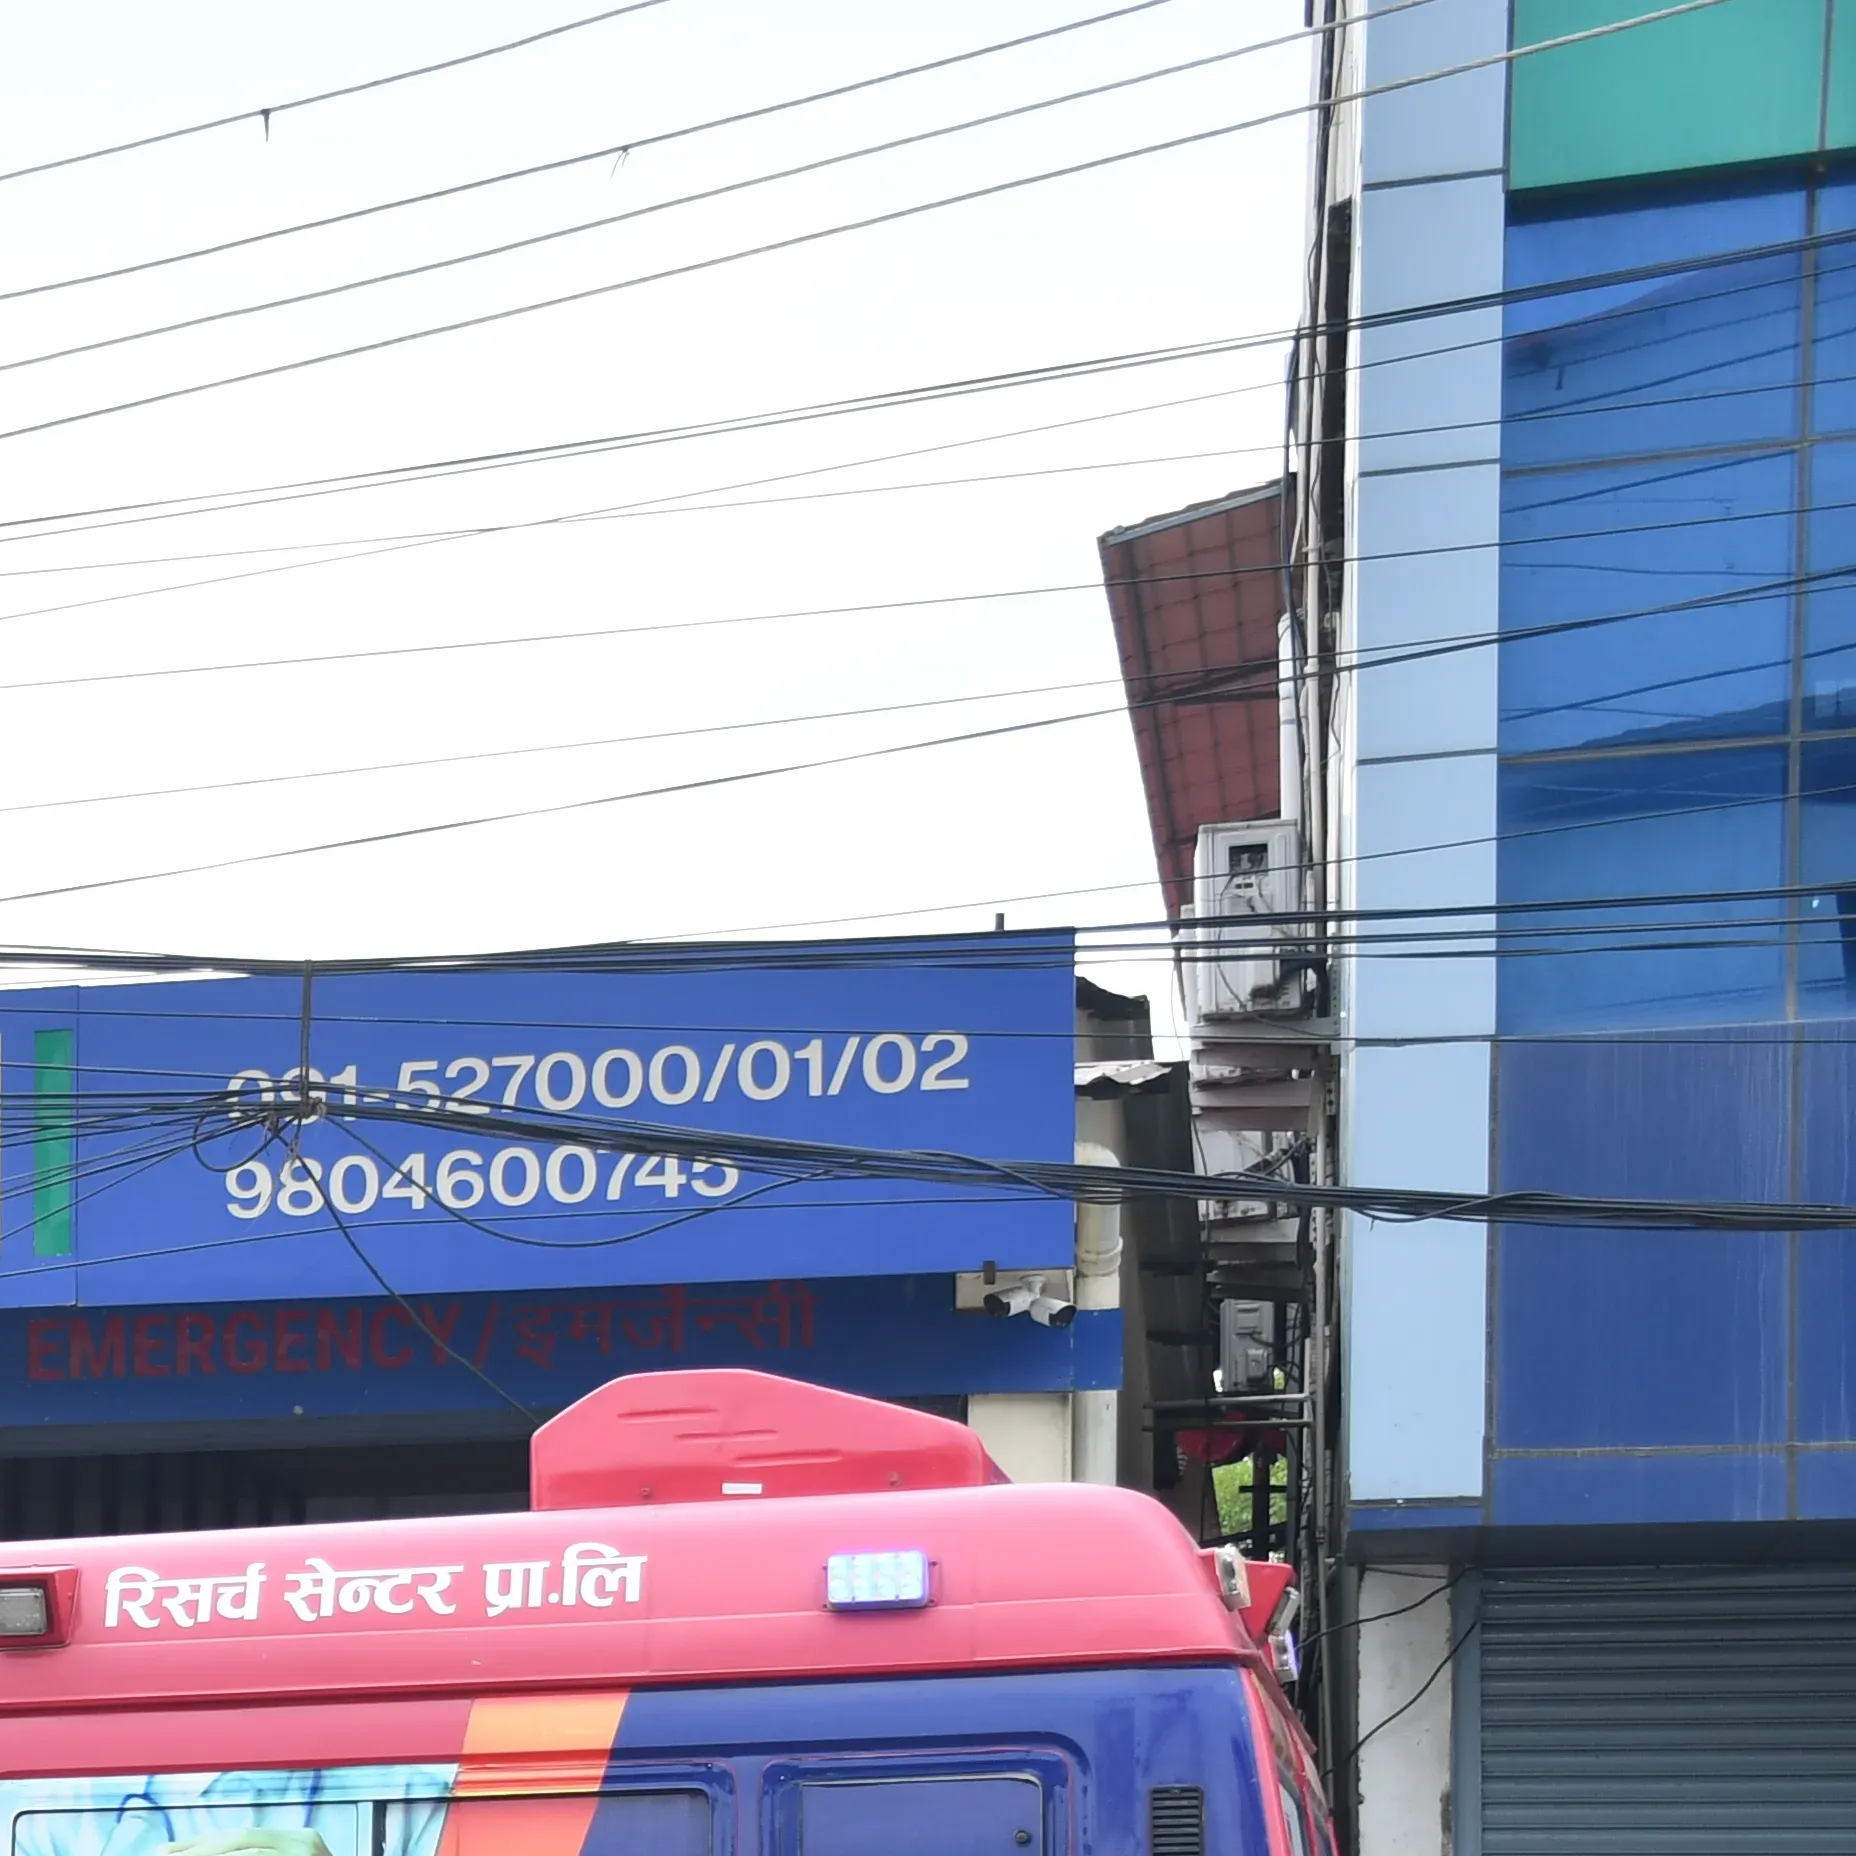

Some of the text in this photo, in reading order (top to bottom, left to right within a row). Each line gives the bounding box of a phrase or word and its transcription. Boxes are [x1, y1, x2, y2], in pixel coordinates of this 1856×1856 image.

[224, 1142, 740, 1220] 9804600745
[104, 1563, 266, 1629] रिसर्च
[285, 1558, 463, 1621] सेन्टर
